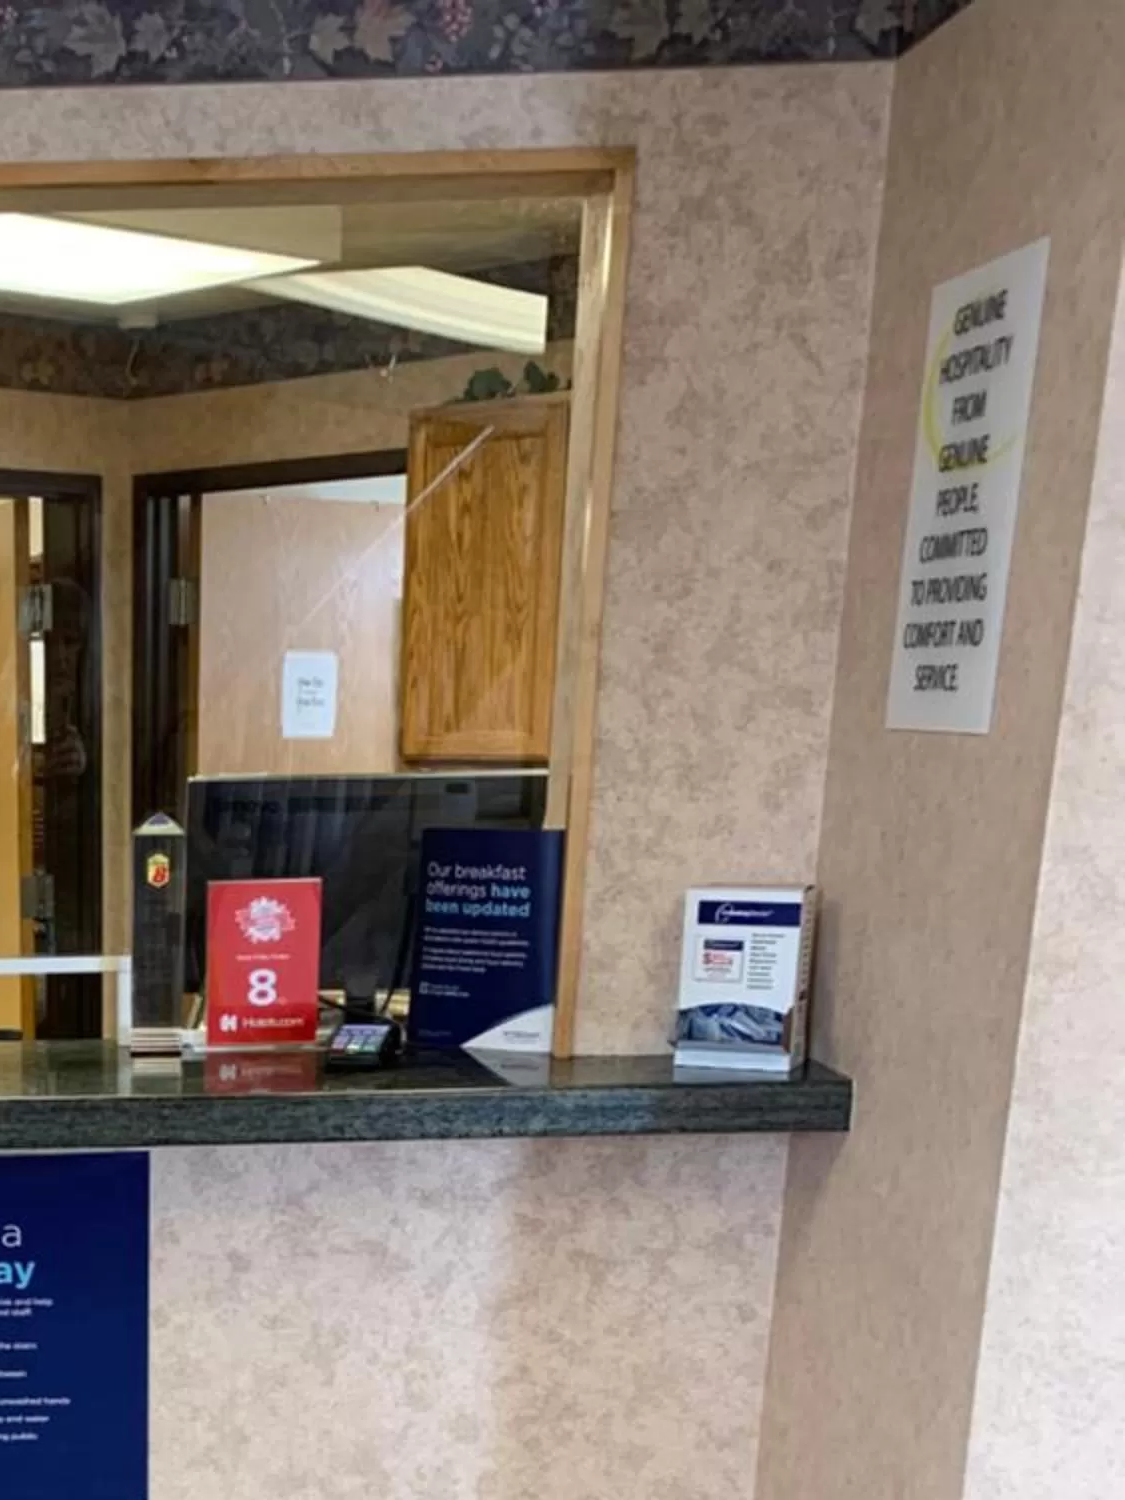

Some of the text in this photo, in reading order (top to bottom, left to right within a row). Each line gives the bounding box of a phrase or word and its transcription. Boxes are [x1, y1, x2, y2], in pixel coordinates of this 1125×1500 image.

[953, 289, 1008, 336] GENUINE
[939, 335, 1013, 385] HOSPITALITY
[952, 390, 987, 425] FROM
[938, 433, 990, 472] GENUINE
[919, 527, 988, 564] COMMITTED
[911, 572, 988, 606] TO PROVIDING
[904, 618, 984, 649] COMFORT AND
[913, 664, 959, 692] SERVICE
[427, 861, 527, 881] Our breakfast
[426, 881, 531, 899] offerings have
[425, 899, 531, 917] been updated
[248, 968, 277, 1007] 8
[1, 1223, 22, 1248] a
